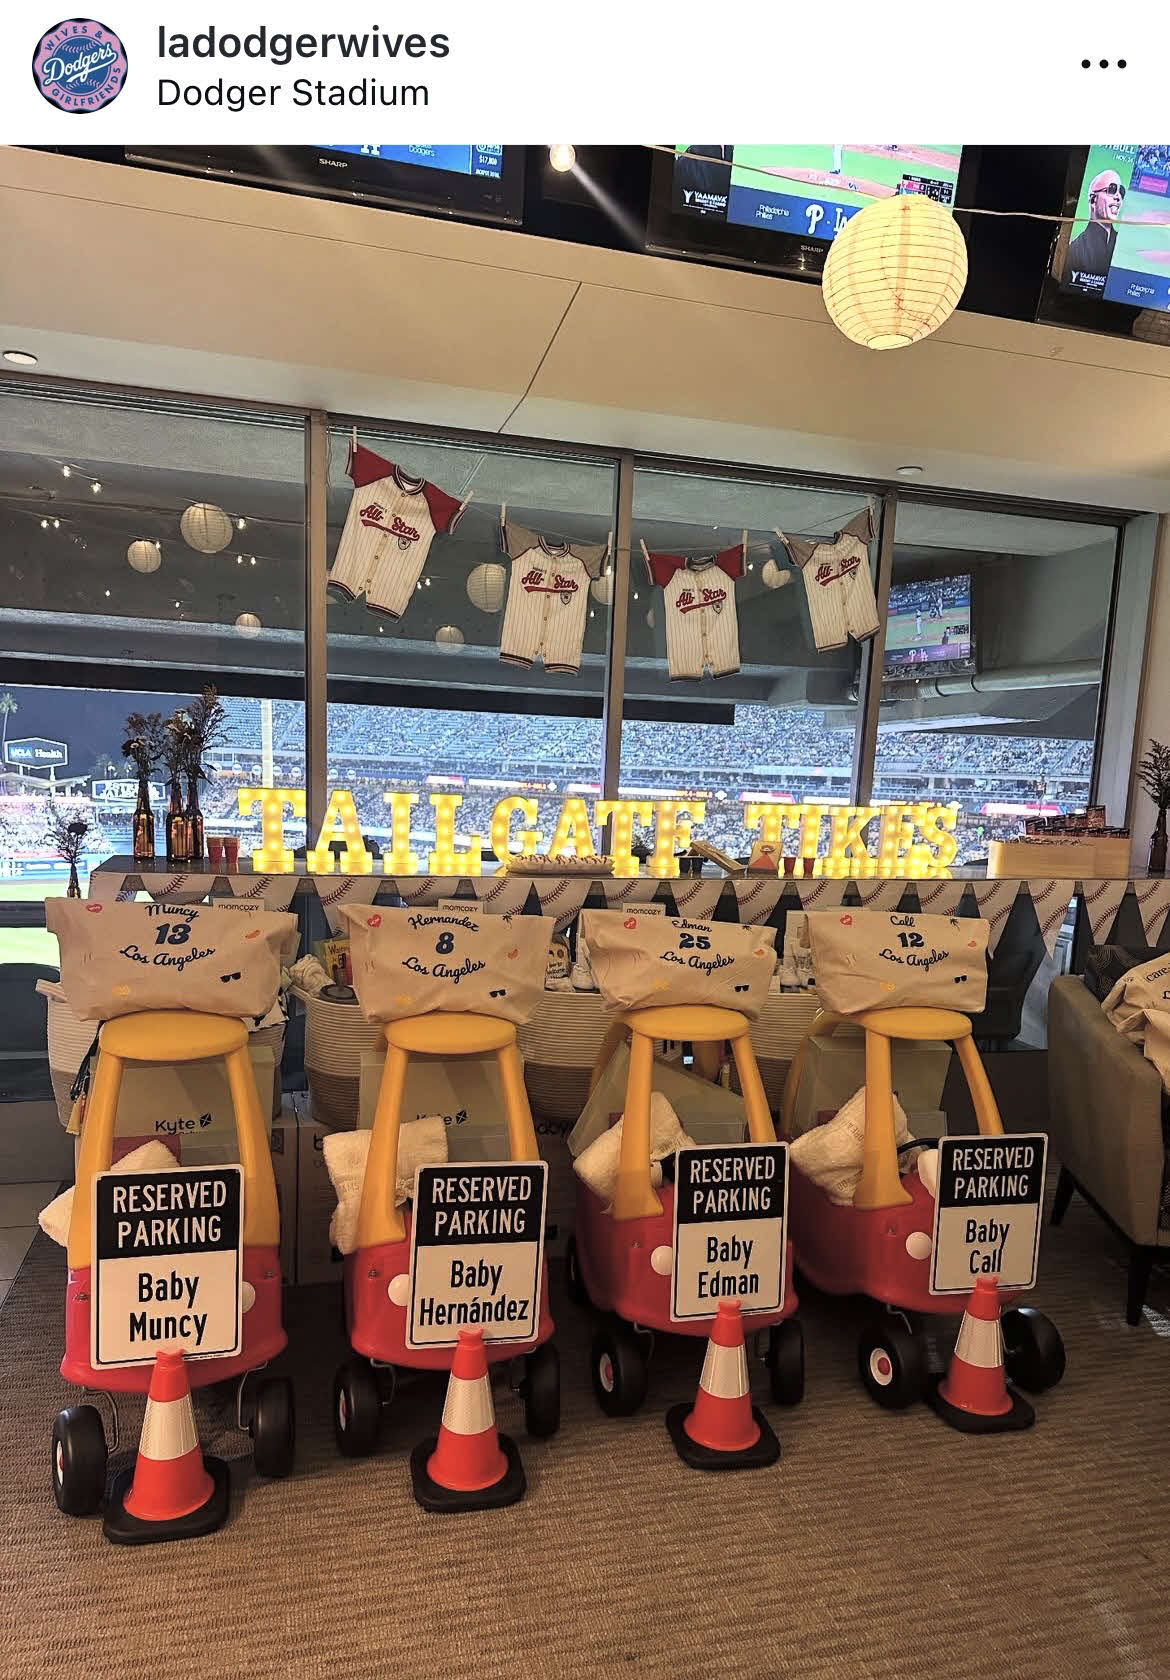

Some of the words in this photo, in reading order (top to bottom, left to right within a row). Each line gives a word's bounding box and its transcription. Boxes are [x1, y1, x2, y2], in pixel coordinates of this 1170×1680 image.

[319, 158, 348, 168] SHARP
[10, 747, 32, 758] UCLA
[34, 748, 62, 759] Health
[238, 788, 705, 877] TAILGATE
[745, 804, 958, 878] TIKES
[145, 903, 199, 922] Muncy
[408, 913, 480, 932] Hernandez
[889, 915, 916, 928] Call
[155, 923, 192, 944] 13
[435, 931, 455, 955] 8
[679, 932, 711, 950] 25
[897, 932, 925, 948] 12
[120, 945, 150, 964] Los
[153, 948, 216, 971] Angeles
[402, 956, 430, 975] Los
[432, 959, 486, 984] Angeles
[660, 951, 686, 965] Los
[689, 955, 735, 976] Angeles
[879, 948, 905, 964] Los
[907, 949, 949, 972] Angeles
[155, 1118, 195, 1135] Kyte
[690, 1156, 776, 1183] RESERVED
[952, 1146, 1034, 1171] RESERVED
[113, 1180, 227, 1213] RESERVED
[432, 1176, 532, 1204] RESERVED
[693, 1186, 771, 1214] PARKING
[954, 1175, 1029, 1200] PARKING
[117, 1215, 221, 1248] PARKING
[434, 1208, 526, 1236] PARKING
[965, 1218, 1010, 1250] Baby
[706, 1234, 754, 1269] Baby
[969, 1250, 1002, 1274] Call
[138, 1270, 200, 1309] Baby
[450, 1258, 503, 1295] Baby
[697, 1271, 760, 1298] Edman
[419, 1297, 529, 1326] Hernández
[129, 1311, 208, 1345] Muncy
